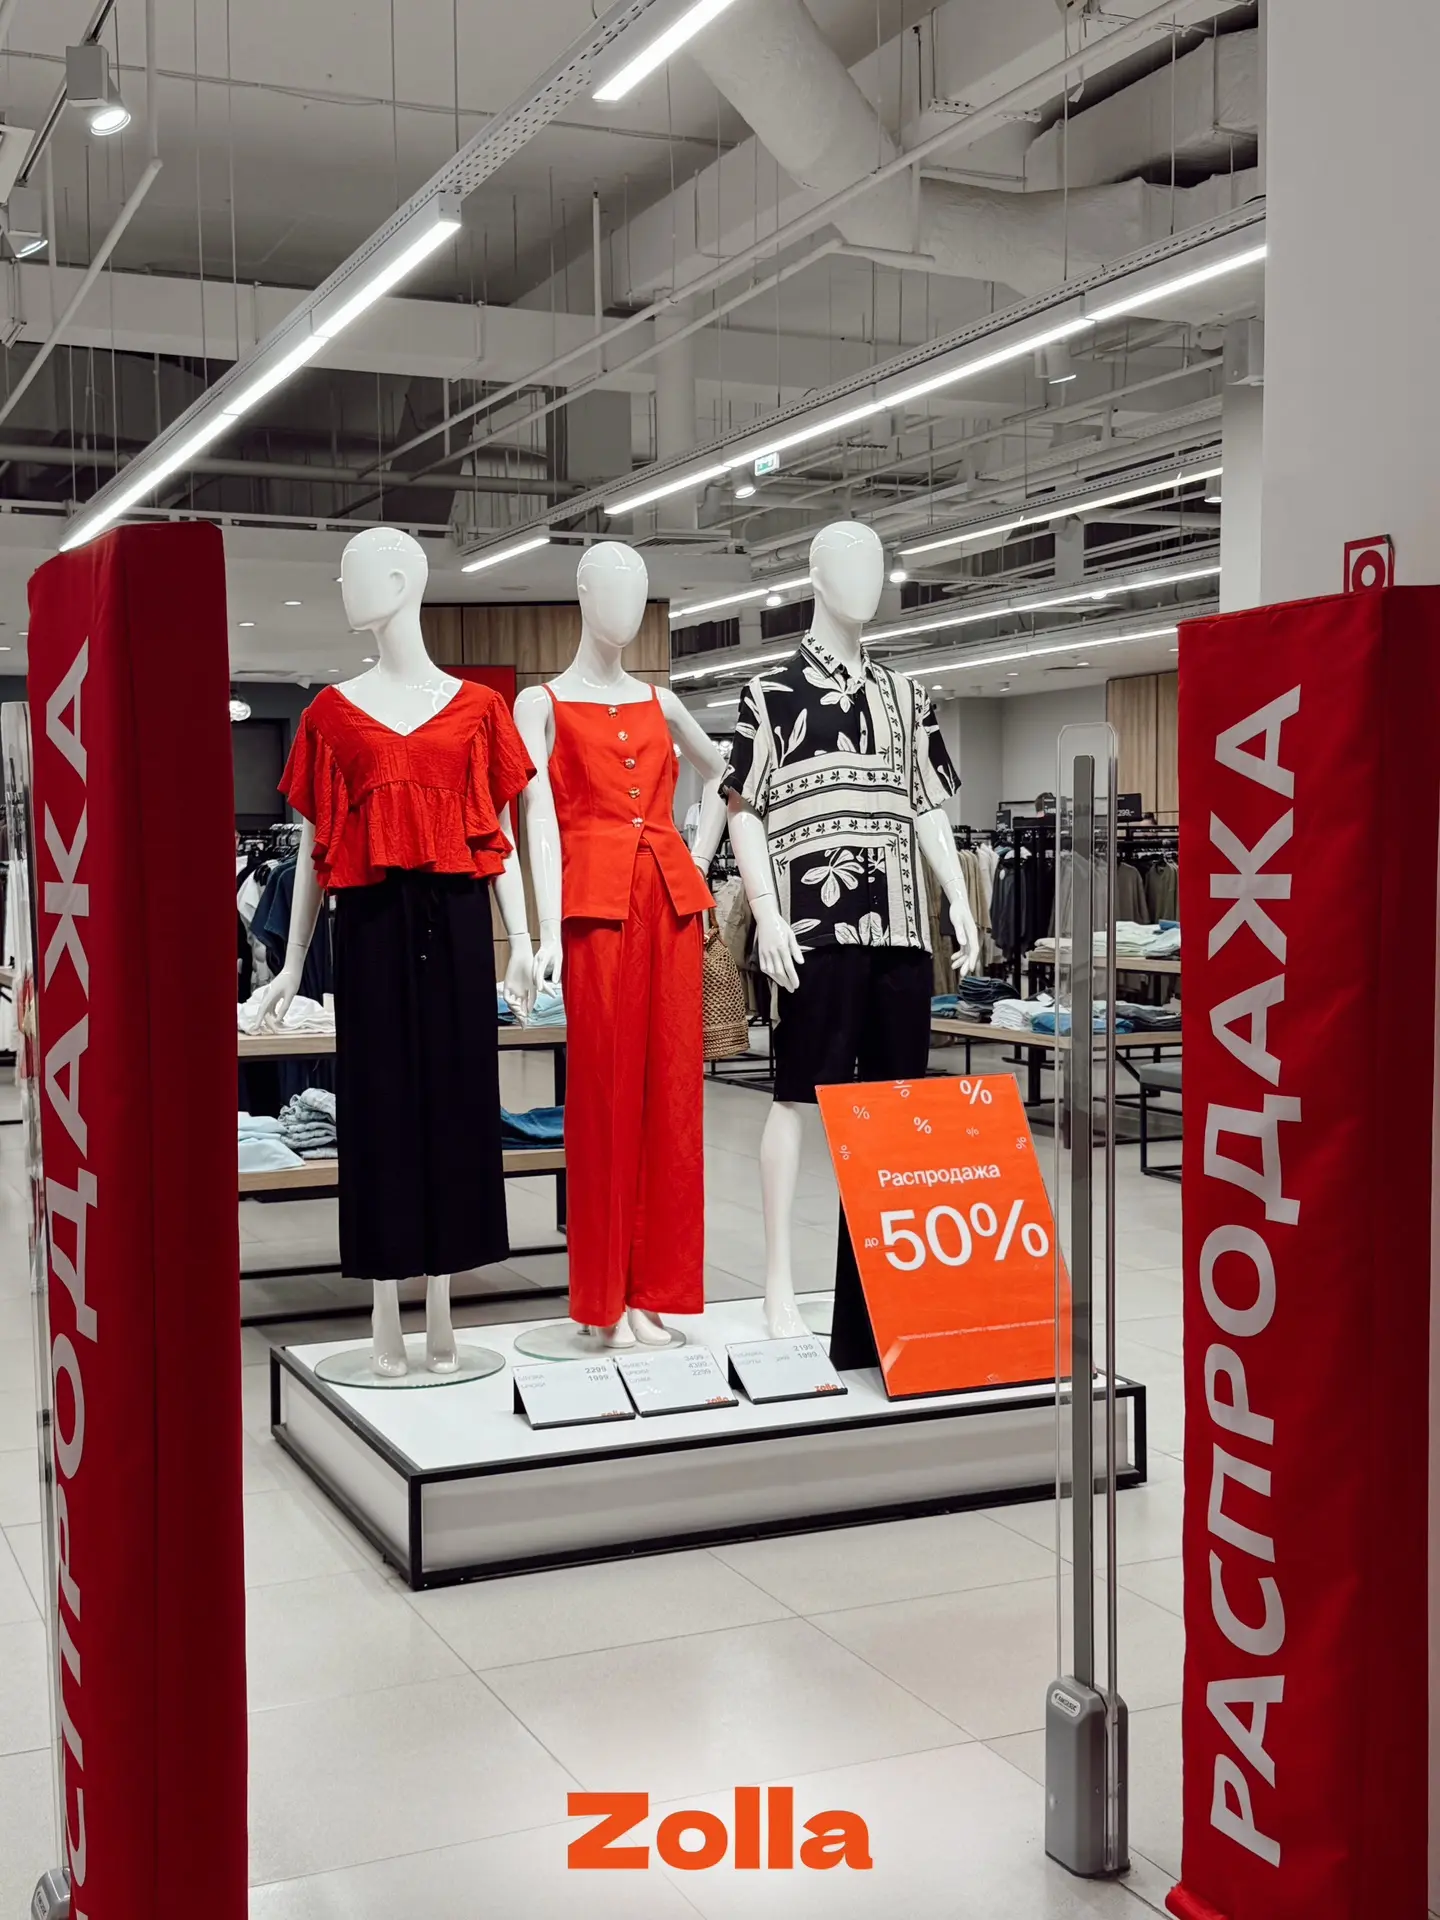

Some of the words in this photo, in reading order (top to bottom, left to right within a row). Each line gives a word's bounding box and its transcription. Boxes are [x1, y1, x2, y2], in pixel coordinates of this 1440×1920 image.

[45, 635, 97, 1920] СПРОДАЖА
[864, 1237, 879, 1248] до
[880, 1199, 1050, 1271] 50%
[877, 1163, 1001, 1187] Распродажа
[1199, 684, 1301, 1867] РАСПРОДАЖА
